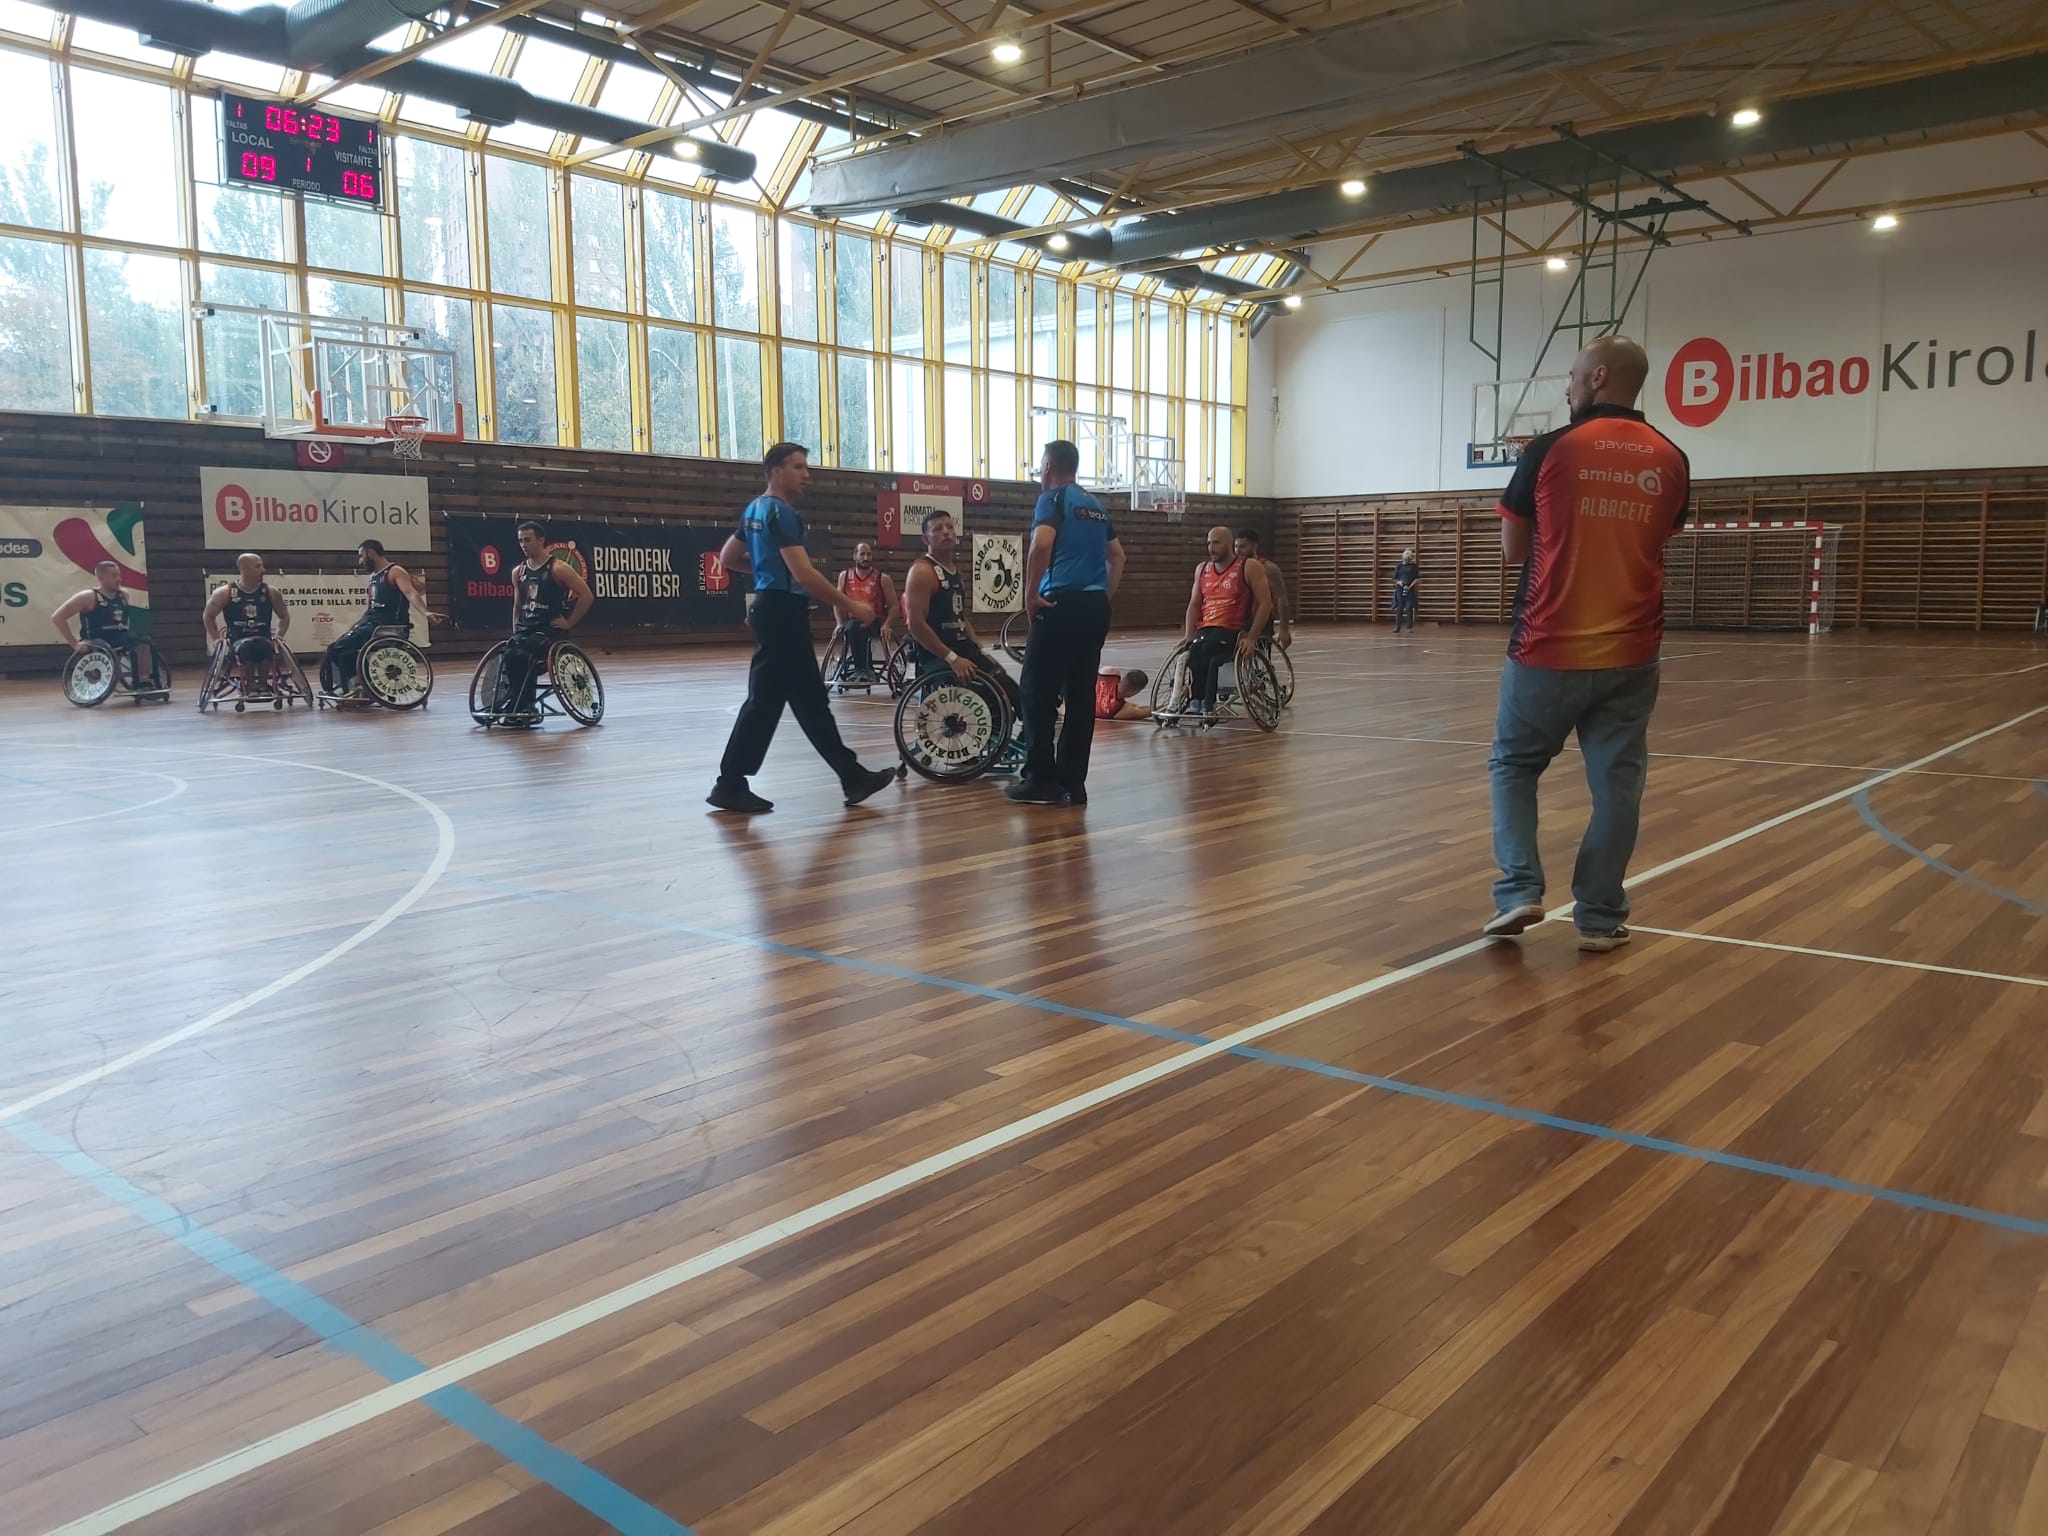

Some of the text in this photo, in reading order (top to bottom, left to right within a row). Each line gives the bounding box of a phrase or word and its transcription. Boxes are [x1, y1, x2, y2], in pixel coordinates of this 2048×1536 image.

[226, 119, 248, 130] FALTAS
[265, 105, 340, 143] 06:23
[231, 131, 274, 149] LOCAL
[334, 150, 373, 168] VISITANTE
[358, 145, 378, 156] FALTAS
[241, 152, 276, 181] 09
[292, 178, 321, 192] PERIODO
[343, 170, 375, 198] 06
[1594, 440, 1655, 454] gaviota
[1578, 467, 1635, 485] amiab
[1580, 497, 1654, 523] ALBACETE
[484, 552, 497, 568] B
[593, 546, 672, 572] BIDAIDEAK
[975, 538, 1017, 581] BILBAO BSR
[467, 580, 514, 598] Bilbao
[595, 573, 680, 598] BILBAO BSR
[981, 572, 1021, 609] FUNDAZIOA
[355, 598, 367, 606] DE
[938, 689, 988, 737] elkarbus
